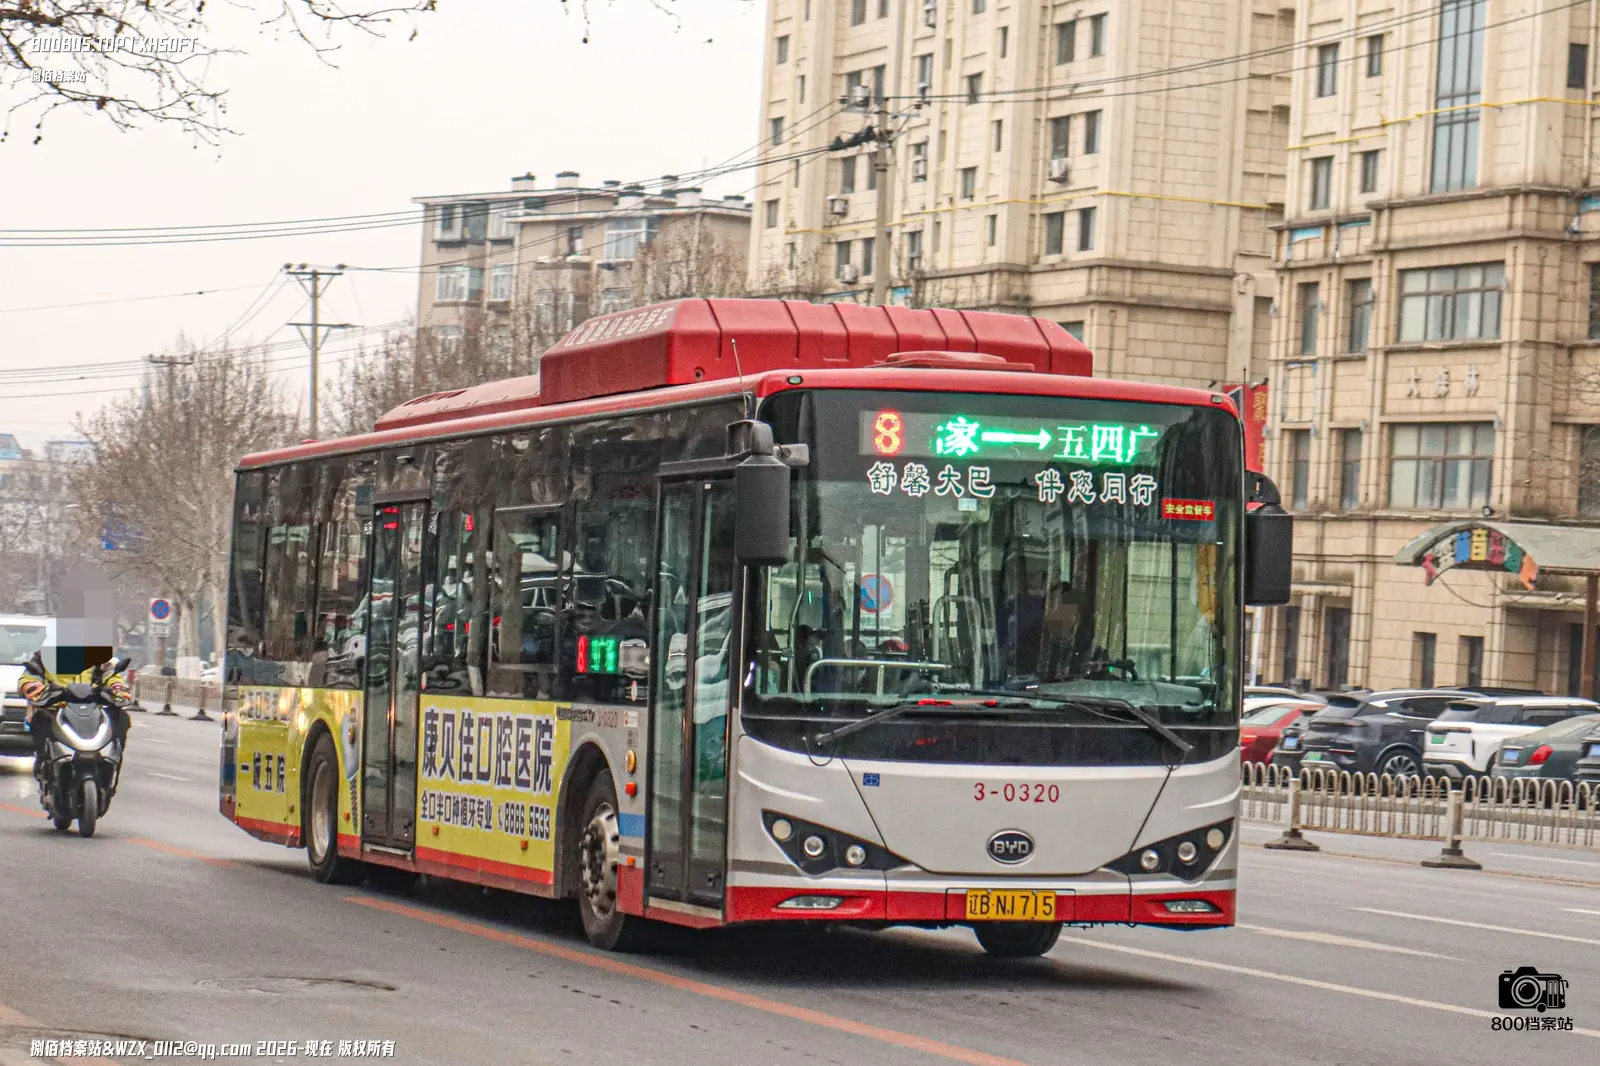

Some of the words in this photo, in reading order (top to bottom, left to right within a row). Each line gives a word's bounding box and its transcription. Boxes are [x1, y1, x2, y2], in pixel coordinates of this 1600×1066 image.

[875, 411, 902, 456] 8
[867, 461, 997, 498] 舒馨大巴
[1034, 468, 1159, 507] 伴您同行
[422, 707, 553, 793] 康贝佳口腔医院
[973, 782, 1060, 803] 3-0320
[993, 839, 1030, 855] BYD
